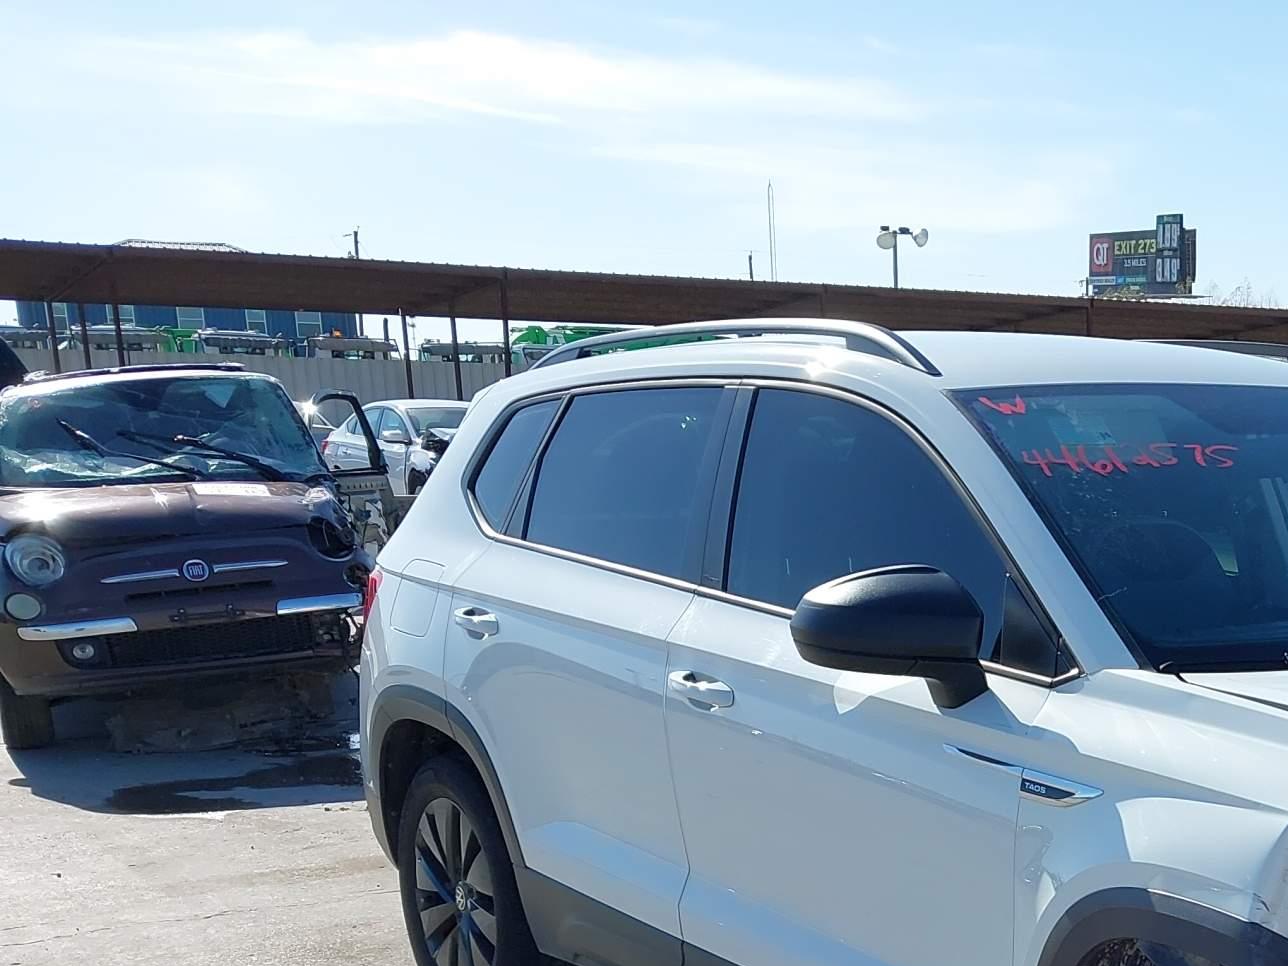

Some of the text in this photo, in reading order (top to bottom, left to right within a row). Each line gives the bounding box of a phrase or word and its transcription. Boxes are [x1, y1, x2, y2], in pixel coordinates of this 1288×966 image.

[1114, 238, 1156, 255] EXIT 273
[1094, 242, 1109, 266] QT
[1131, 258, 1147, 267] MILES
[188, 564, 204, 577] FIAT
[1024, 782, 1046, 794] TAOS
